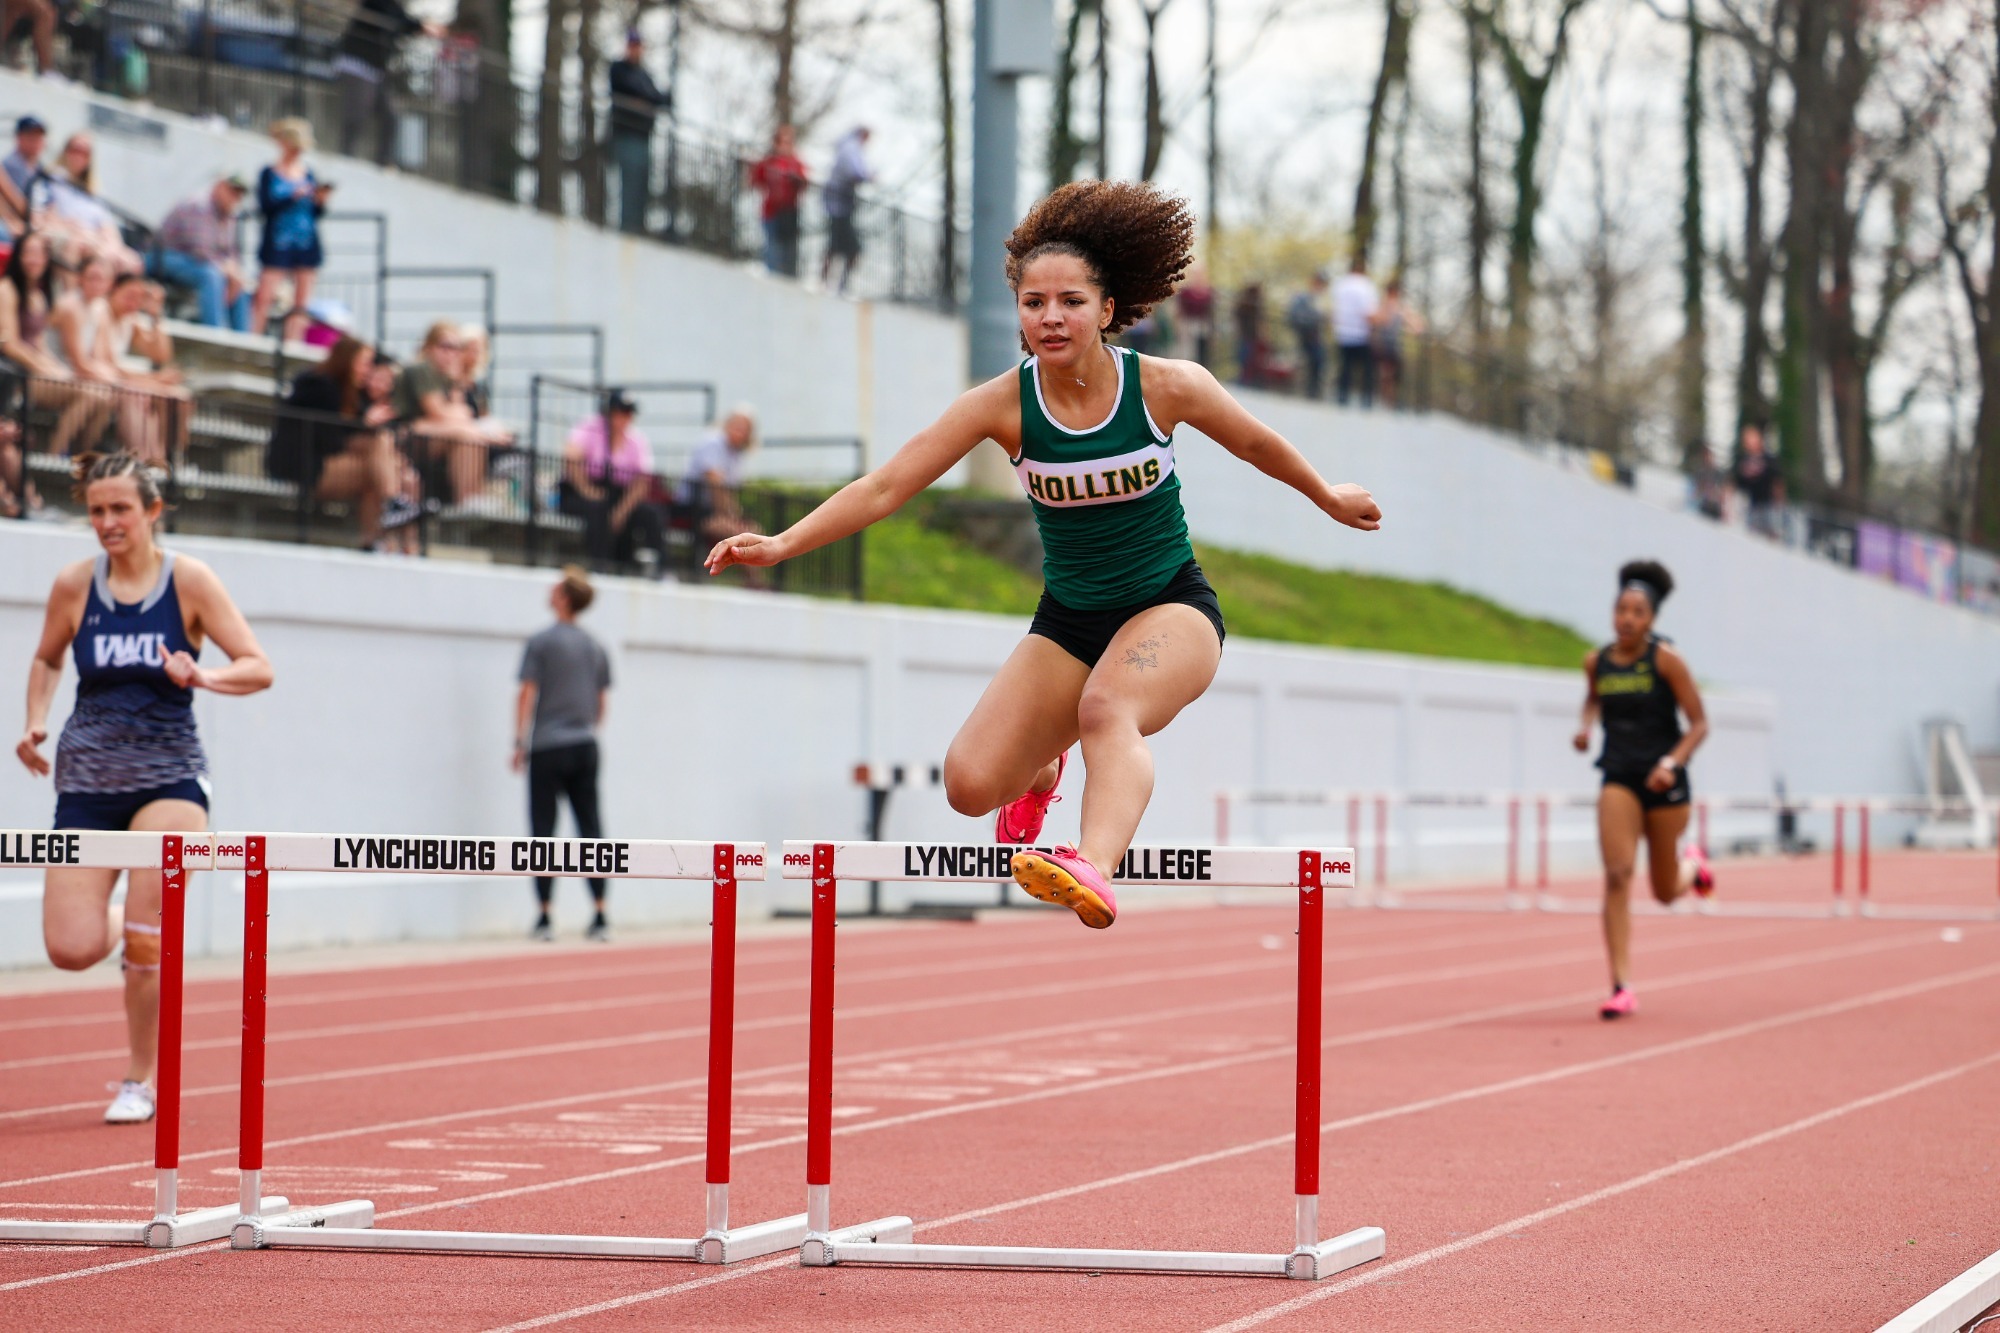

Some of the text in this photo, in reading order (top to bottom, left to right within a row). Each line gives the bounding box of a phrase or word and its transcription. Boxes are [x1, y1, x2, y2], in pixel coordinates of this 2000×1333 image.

[1028, 458, 1161, 501] HOLLINS
[1, 834, 79, 863] LLEGE
[334, 838, 629, 873] LYNCHBURG COLLEGE
[905, 846, 1211, 880] LYNCHB LLEGE
